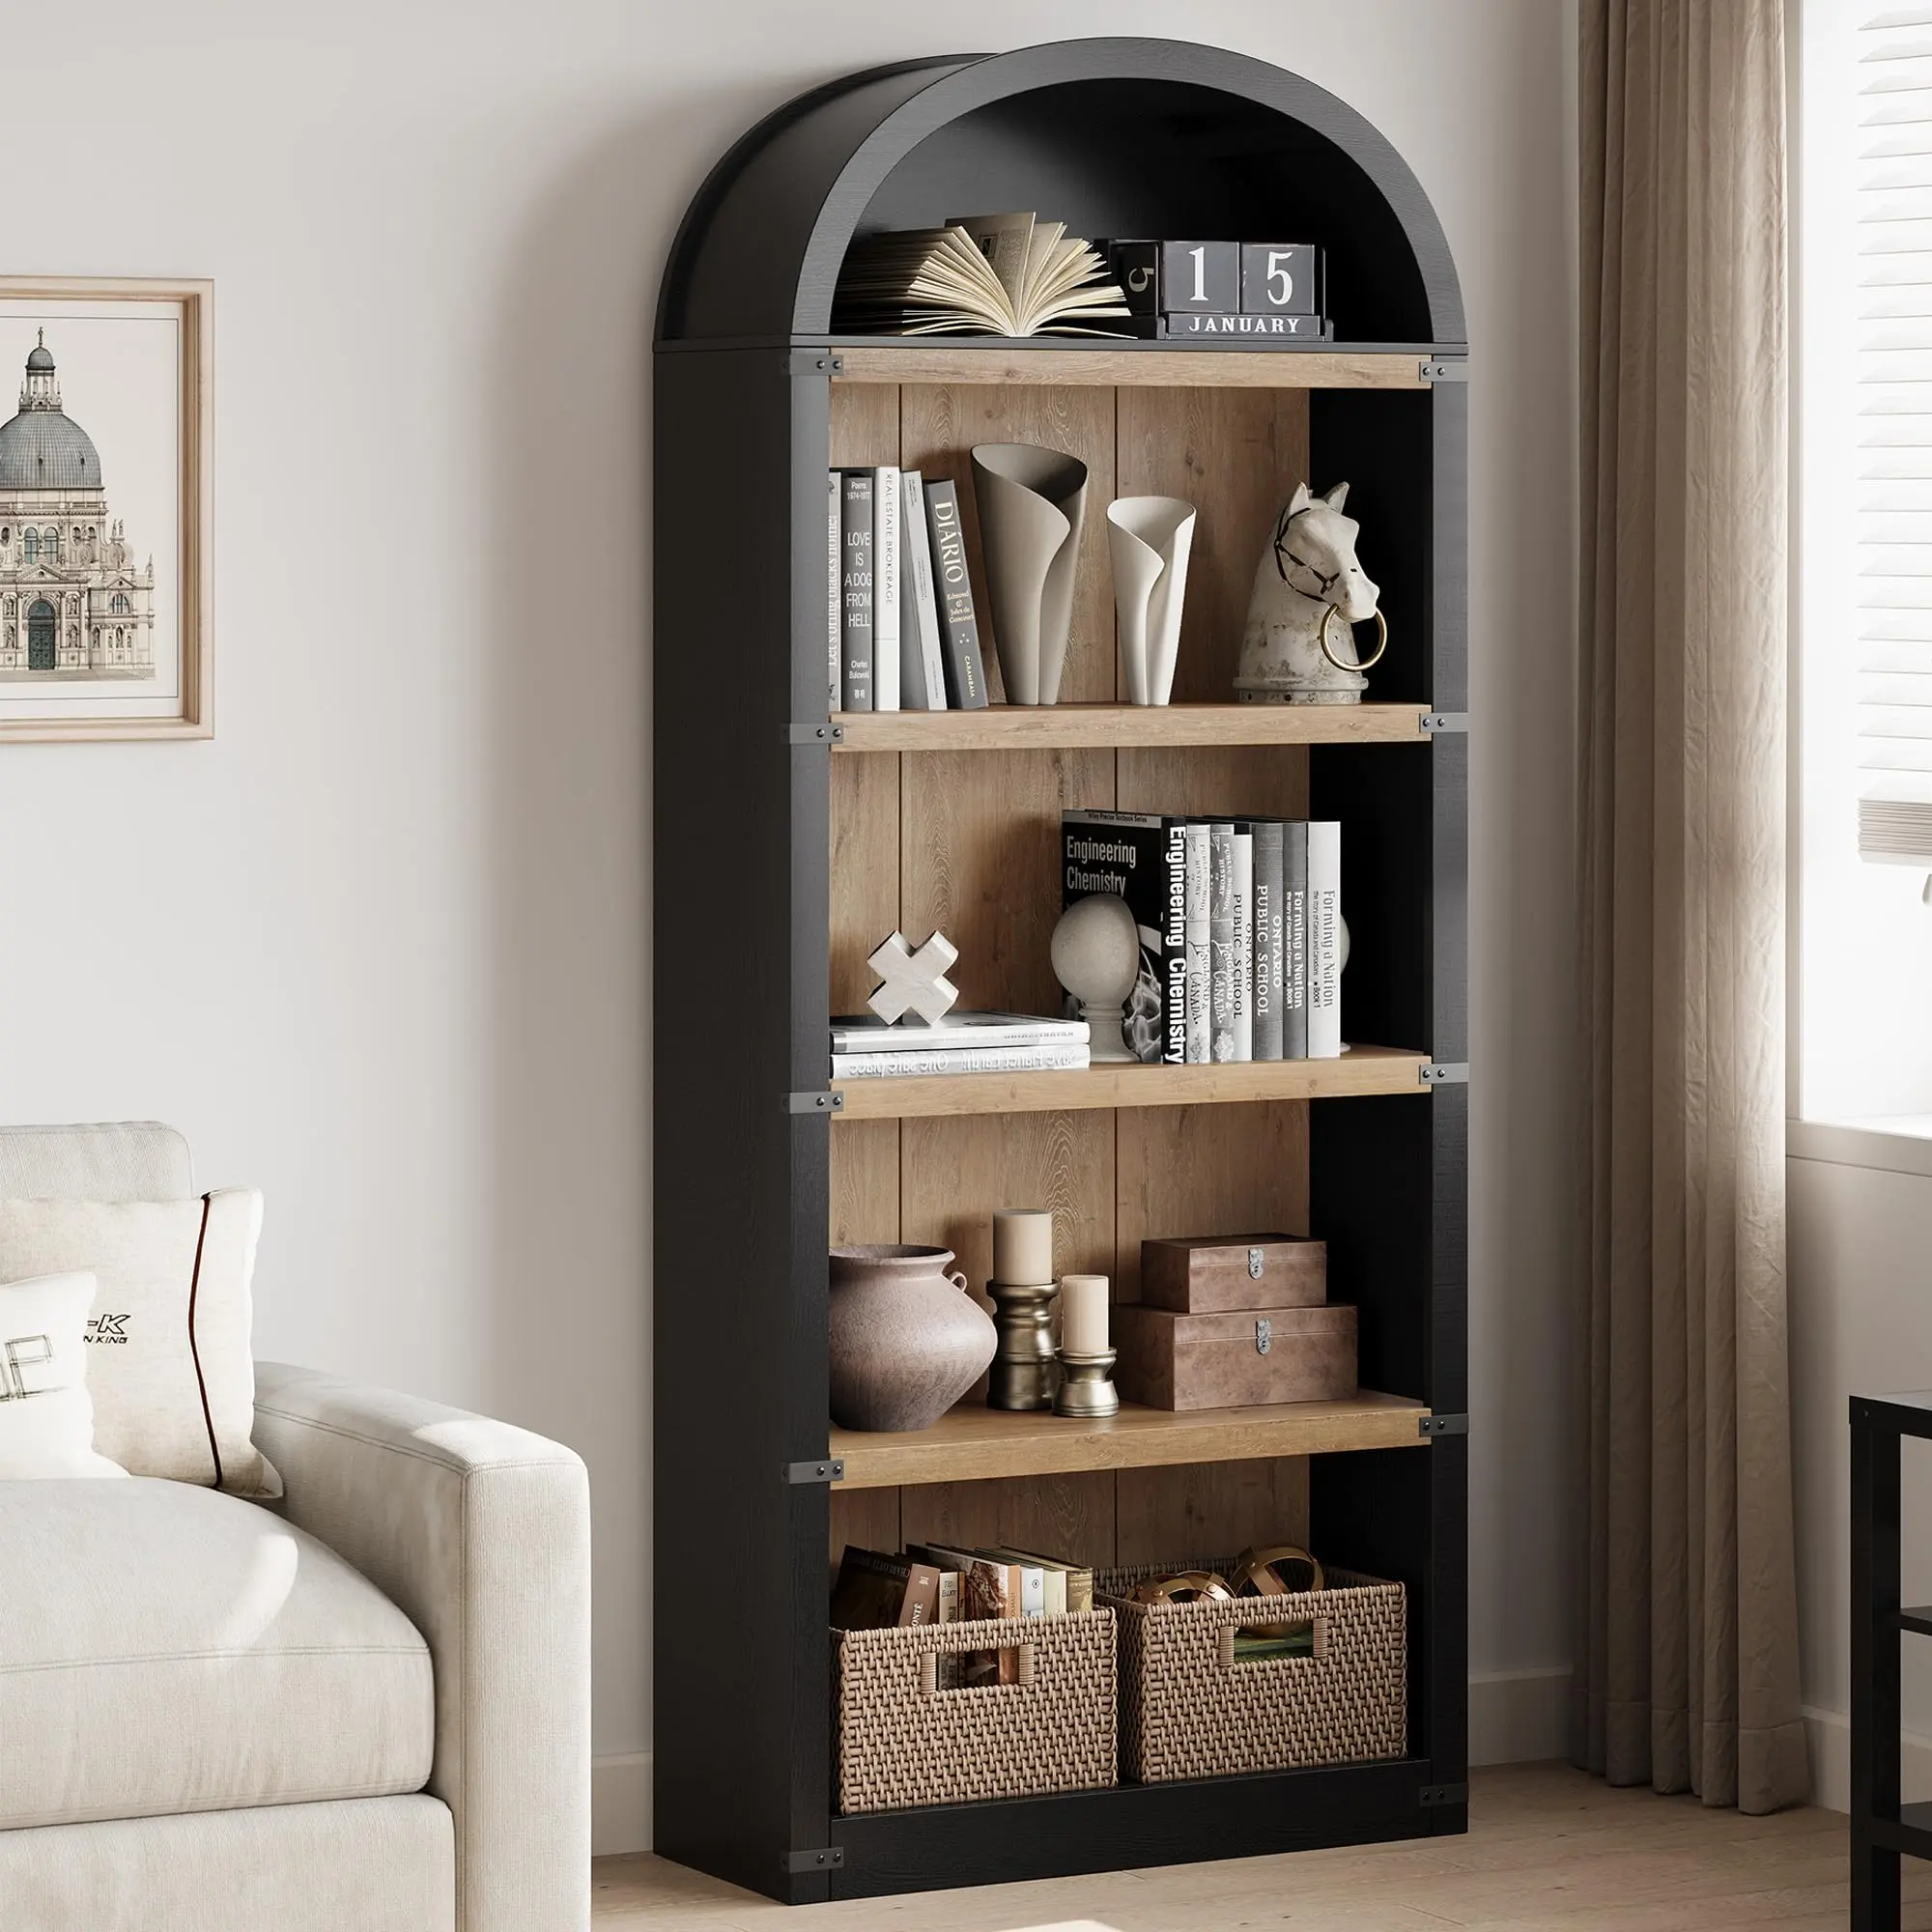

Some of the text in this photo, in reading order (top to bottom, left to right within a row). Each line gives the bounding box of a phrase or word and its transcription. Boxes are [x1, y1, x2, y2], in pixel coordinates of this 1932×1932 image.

[1188, 246, 1293, 305] 1 5
[1188, 316, 1300, 333] JANUARY
[847, 531, 870, 547] LOVE
[855, 552, 864, 566] IS
[885, 473, 894, 604] REAL-ESTATE BROKERAGE
[844, 572, 872, 587] A DOG
[846, 592, 871, 608] FROM
[848, 613, 870, 627] HELL
[1066, 836, 1136, 868] Engineering
[1066, 866, 1126, 897] Chemistry
[1293, 891, 1304, 949] Forming
[1321, 891, 1335, 948] Forming
[1165, 826, 1186, 1064] Engineering Chemistry
[1233, 895, 1242, 1019] PUBLIC SCHOOL
[1257, 885, 1268, 1016] PUBLIC SCHOOL
[1273, 915, 1282, 987] ONTARIO
[1189, 971, 1203, 1025] CANADA.
[1294, 962, 1304, 1009] Nation
[1323, 962, 1337, 1008] Nation
[96, 1335, 128, 1344] KING
